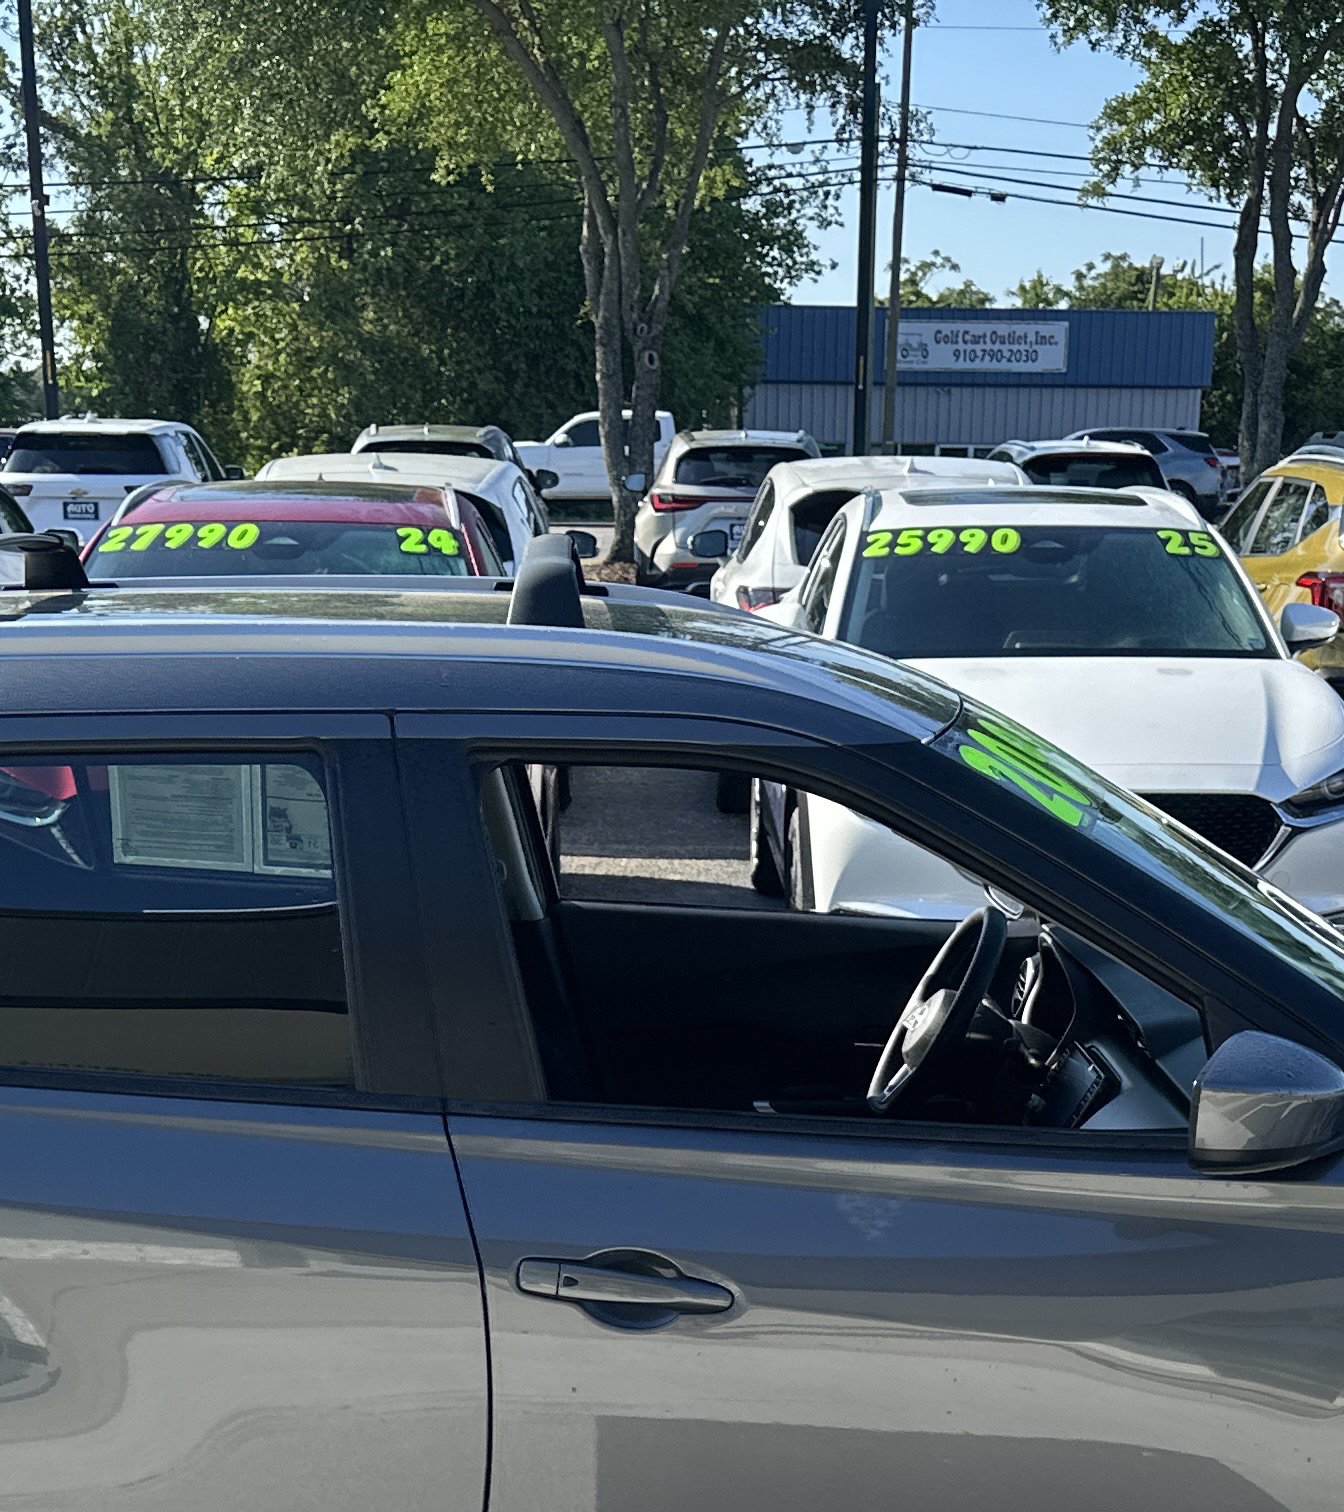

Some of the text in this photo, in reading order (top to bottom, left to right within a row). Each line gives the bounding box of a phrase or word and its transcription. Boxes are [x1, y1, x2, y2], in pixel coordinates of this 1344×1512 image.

[934, 330, 960, 345] Golf
[962, 330, 987, 345] Cart
[953, 348, 1039, 363] 910-790-2030
[67, 503, 95, 514] AUTO
[98, 522, 460, 556] 27990 24
[862, 527, 1220, 558] 25990 25
